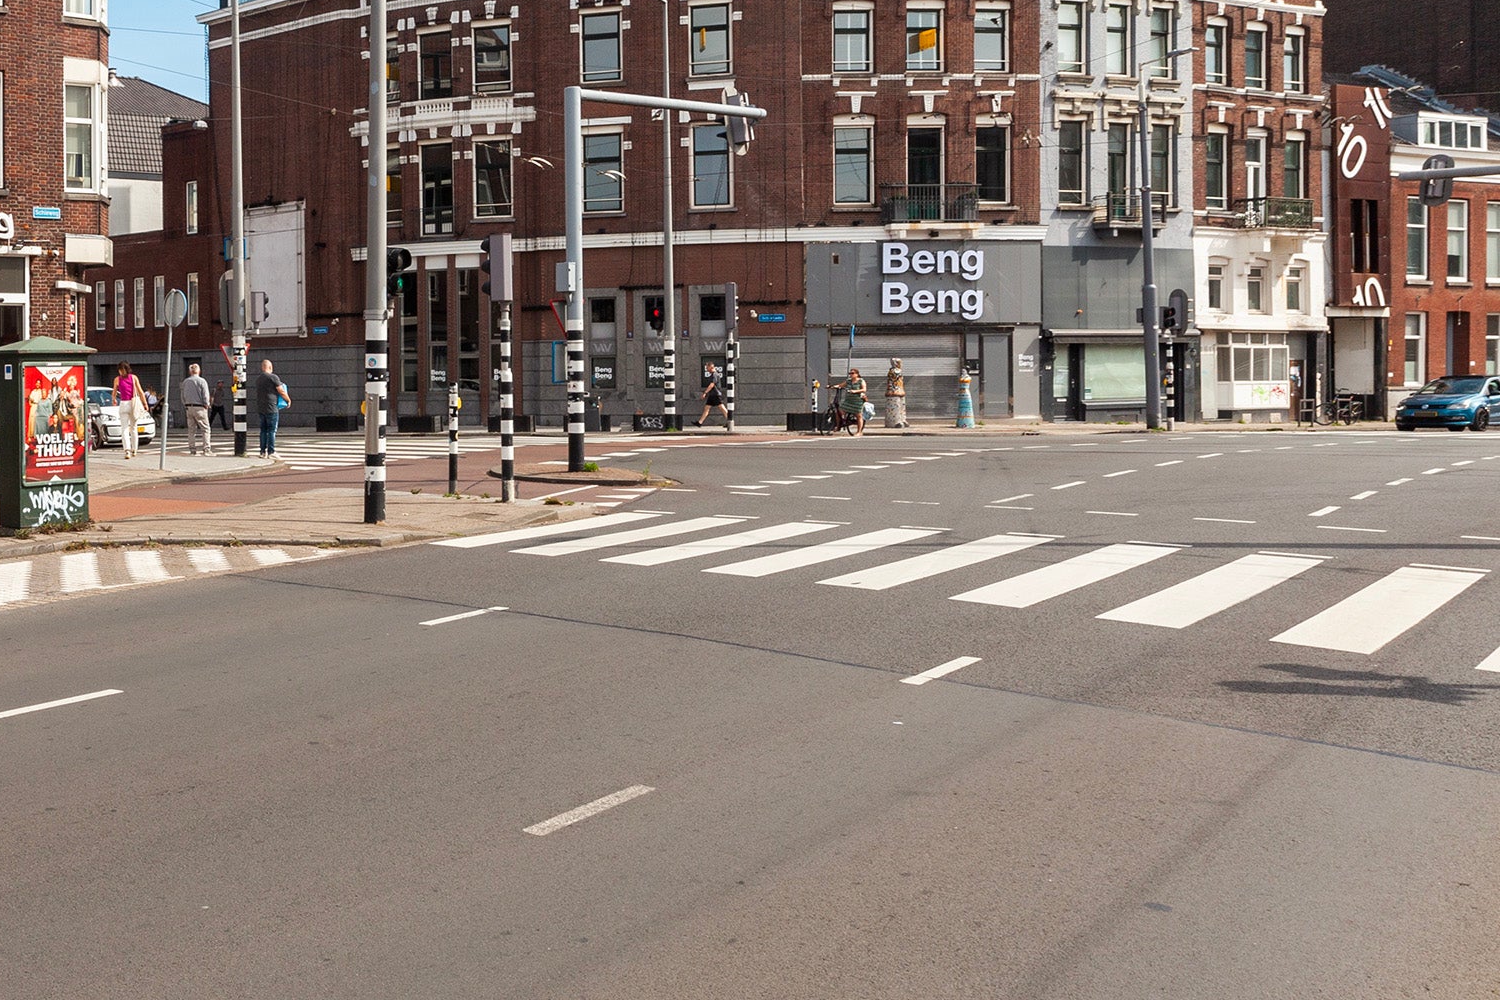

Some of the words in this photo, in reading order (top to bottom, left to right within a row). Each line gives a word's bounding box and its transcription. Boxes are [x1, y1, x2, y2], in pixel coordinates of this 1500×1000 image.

[882, 242, 984, 281] Beng
[882, 282, 984, 321] Beng
[36, 433, 62, 445] VOEL
[63, 432, 74, 444] JE
[36, 443, 74, 457] THUIS
